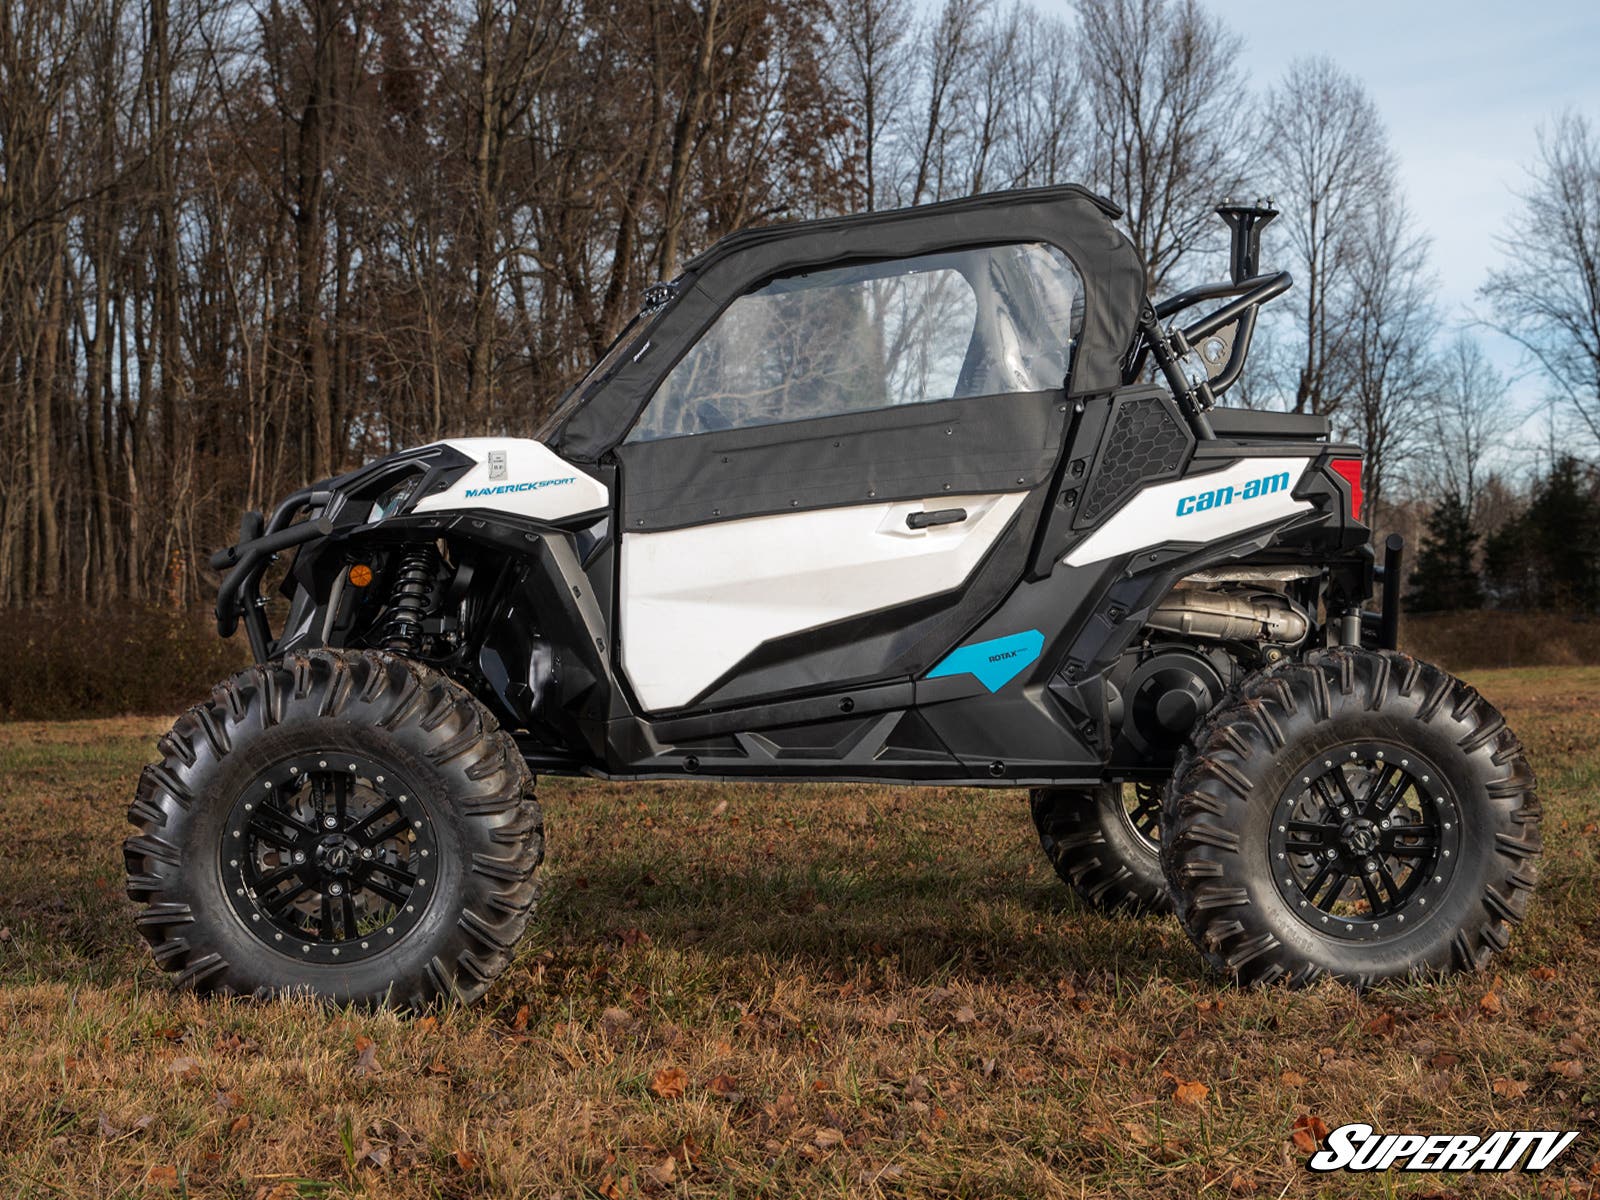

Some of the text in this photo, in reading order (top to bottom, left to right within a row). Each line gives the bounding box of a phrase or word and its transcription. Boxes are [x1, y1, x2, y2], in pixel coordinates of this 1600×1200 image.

[465, 482, 538, 498] MAVERICK
[1176, 472, 1290, 517] can-am
[988, 650, 1017, 662] ROTAX
